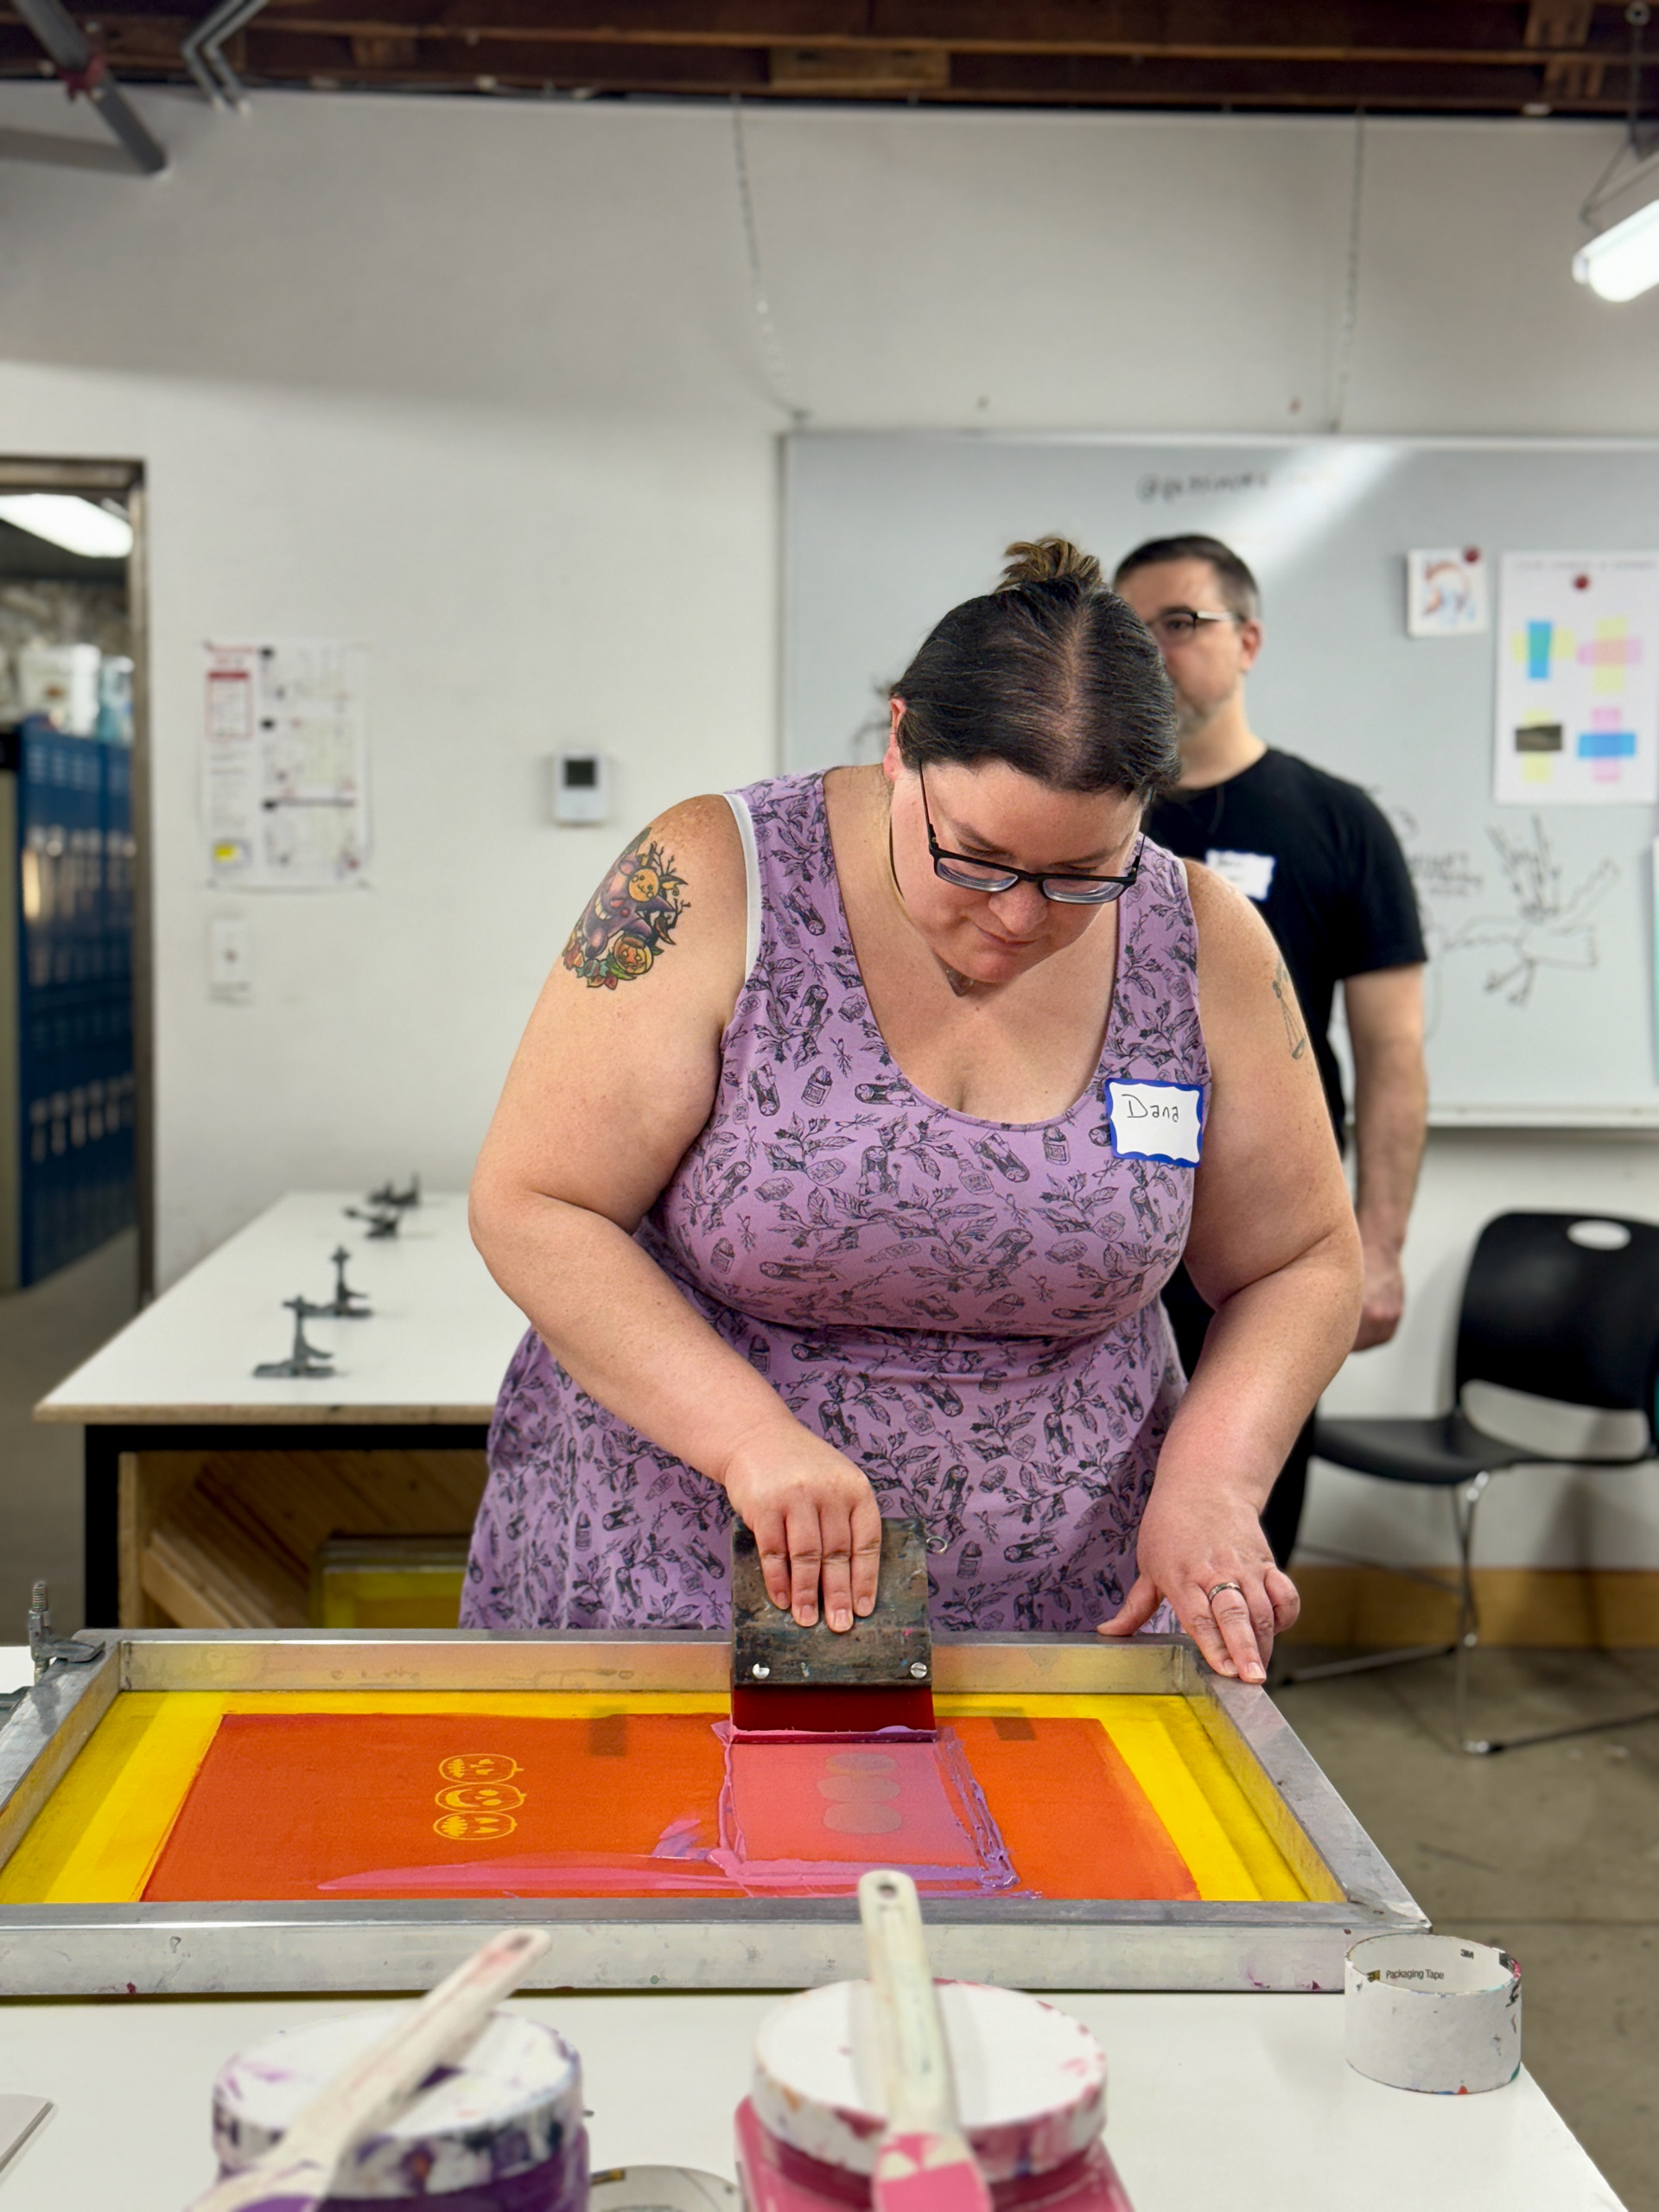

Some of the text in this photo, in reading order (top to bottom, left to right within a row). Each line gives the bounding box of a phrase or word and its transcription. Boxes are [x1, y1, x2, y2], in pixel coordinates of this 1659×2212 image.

[1122, 1093, 1179, 1122] Dana
[1460, 1948, 1474, 1960] 3M
[1386, 1969, 1445, 1980] Packaging Tape
